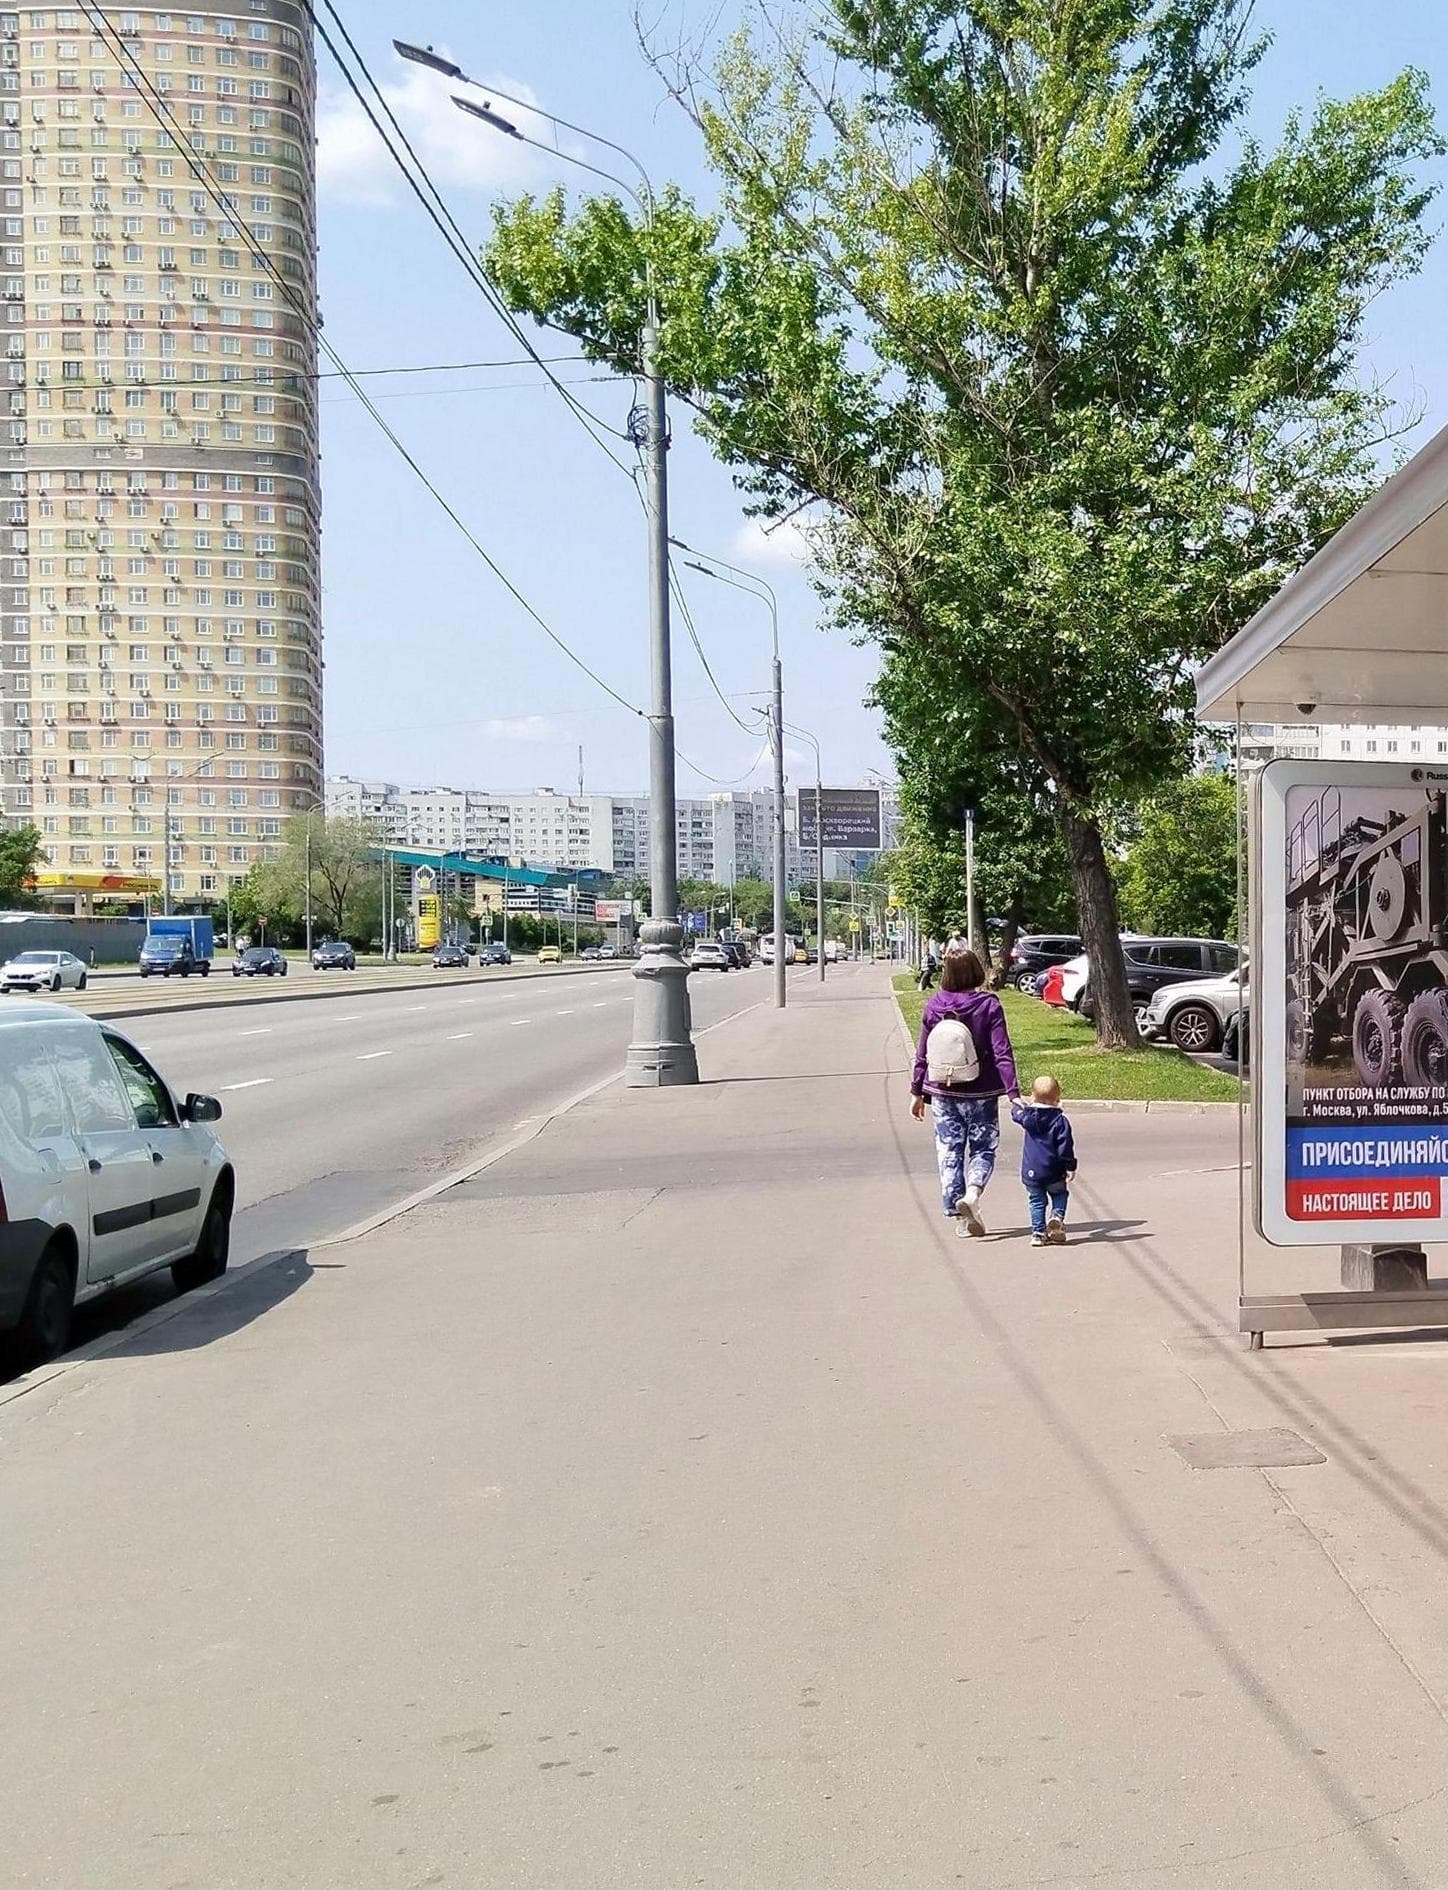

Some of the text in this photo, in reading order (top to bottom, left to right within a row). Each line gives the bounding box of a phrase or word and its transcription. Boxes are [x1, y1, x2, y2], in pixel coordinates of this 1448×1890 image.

[1426, 771, 1448, 780] Russ
[1303, 1088, 1334, 1101] ПУНКТ
[1336, 1088, 1373, 1100] ОТБОРА
[1376, 1088, 1389, 1099] НА
[1390, 1086, 1430, 1100] СЛУЖБУ
[1432, 1086, 1446, 1098] ПО
[1303, 1106, 1311, 1116] г.
[1312, 1104, 1354, 1118] Москва,
[1357, 1105, 1372, 1118] ул.
[1373, 1103, 1432, 1117] Яблочкова,
[1302, 1190, 1431, 1213] НАСТОЯЩЕЕ ДЕЛО
